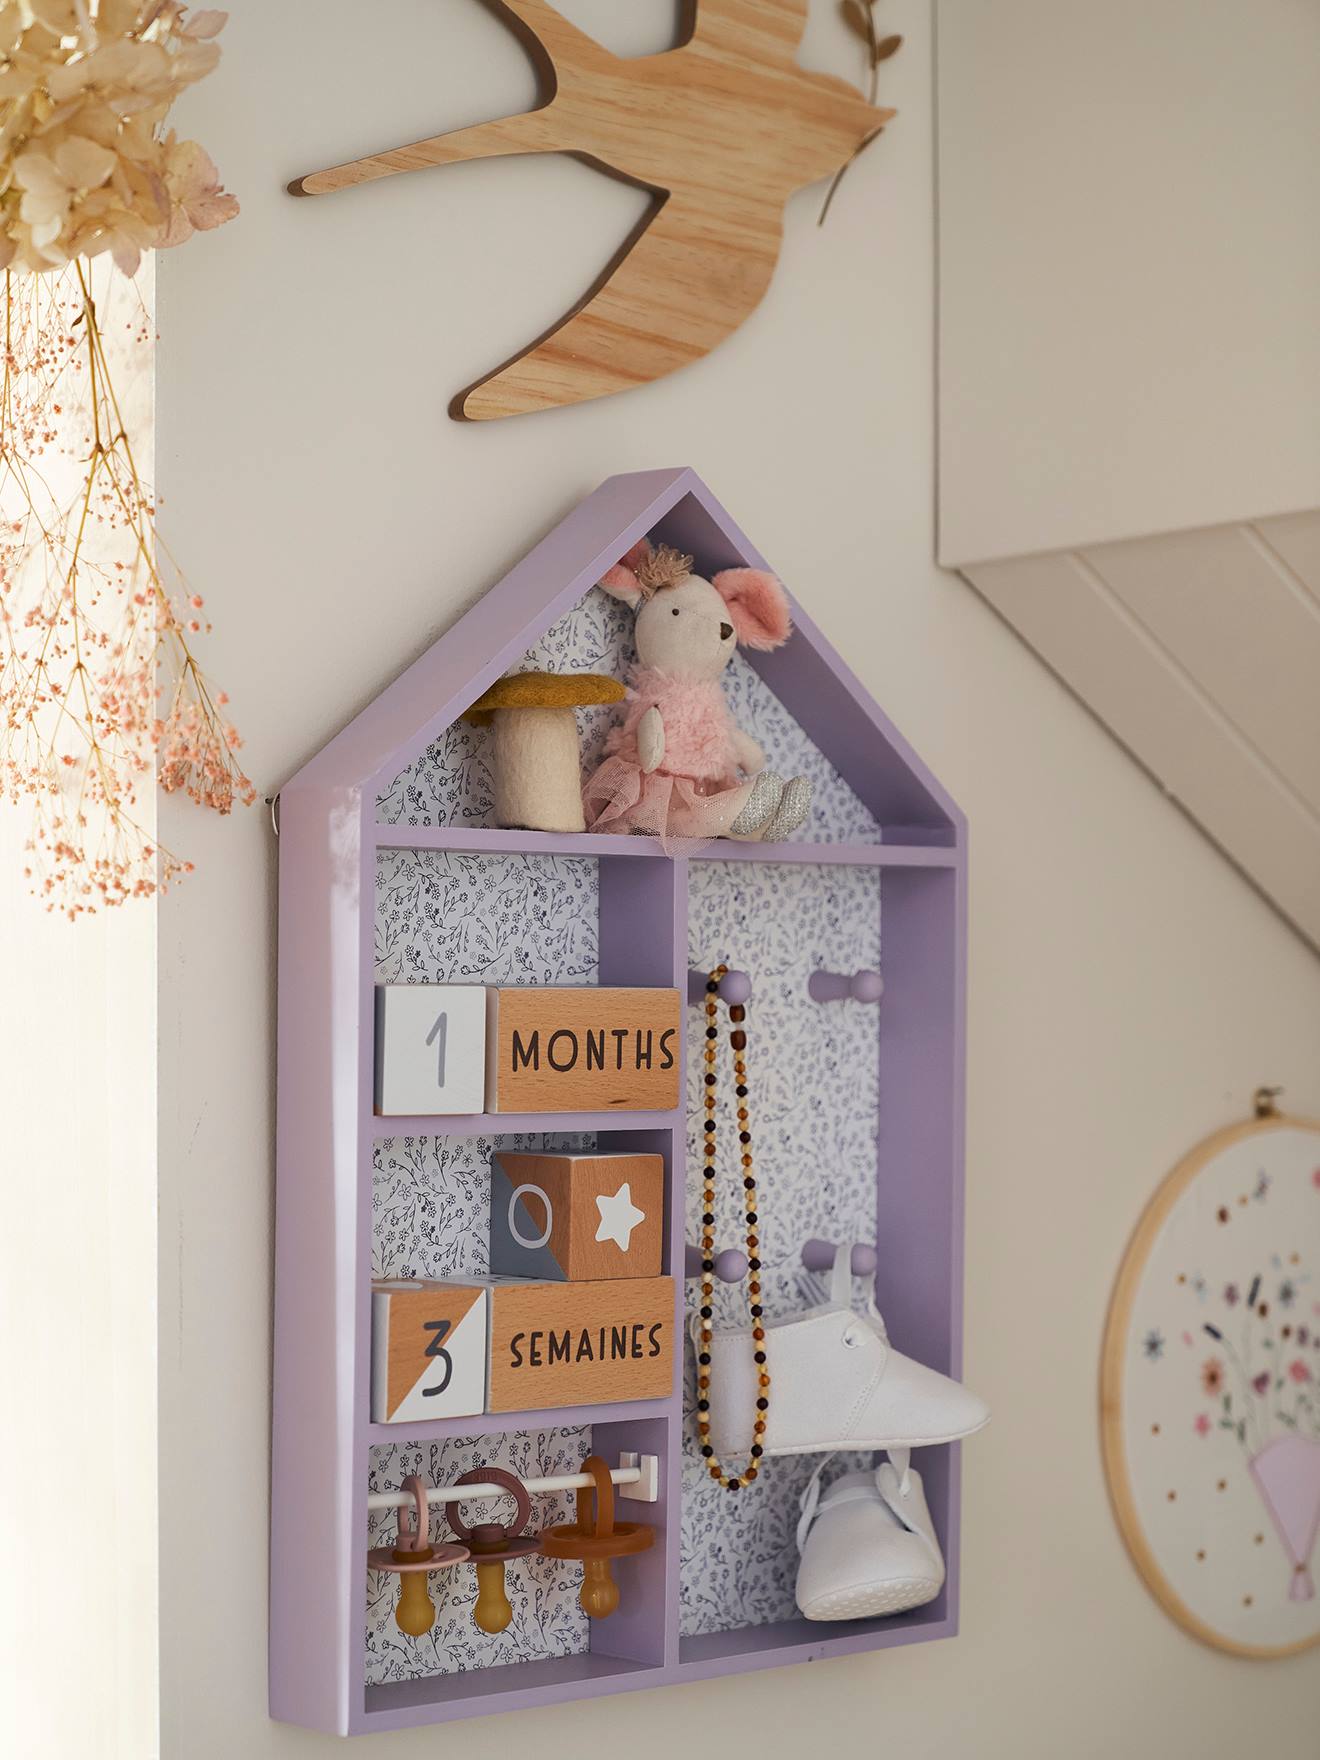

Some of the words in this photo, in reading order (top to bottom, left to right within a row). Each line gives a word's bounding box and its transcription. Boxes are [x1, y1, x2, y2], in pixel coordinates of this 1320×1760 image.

[425, 1012, 448, 1088] 1
[512, 1028, 677, 1072] MONTHS
[422, 1320, 453, 1397] 3
[510, 1322, 663, 1368] SEMAINES
